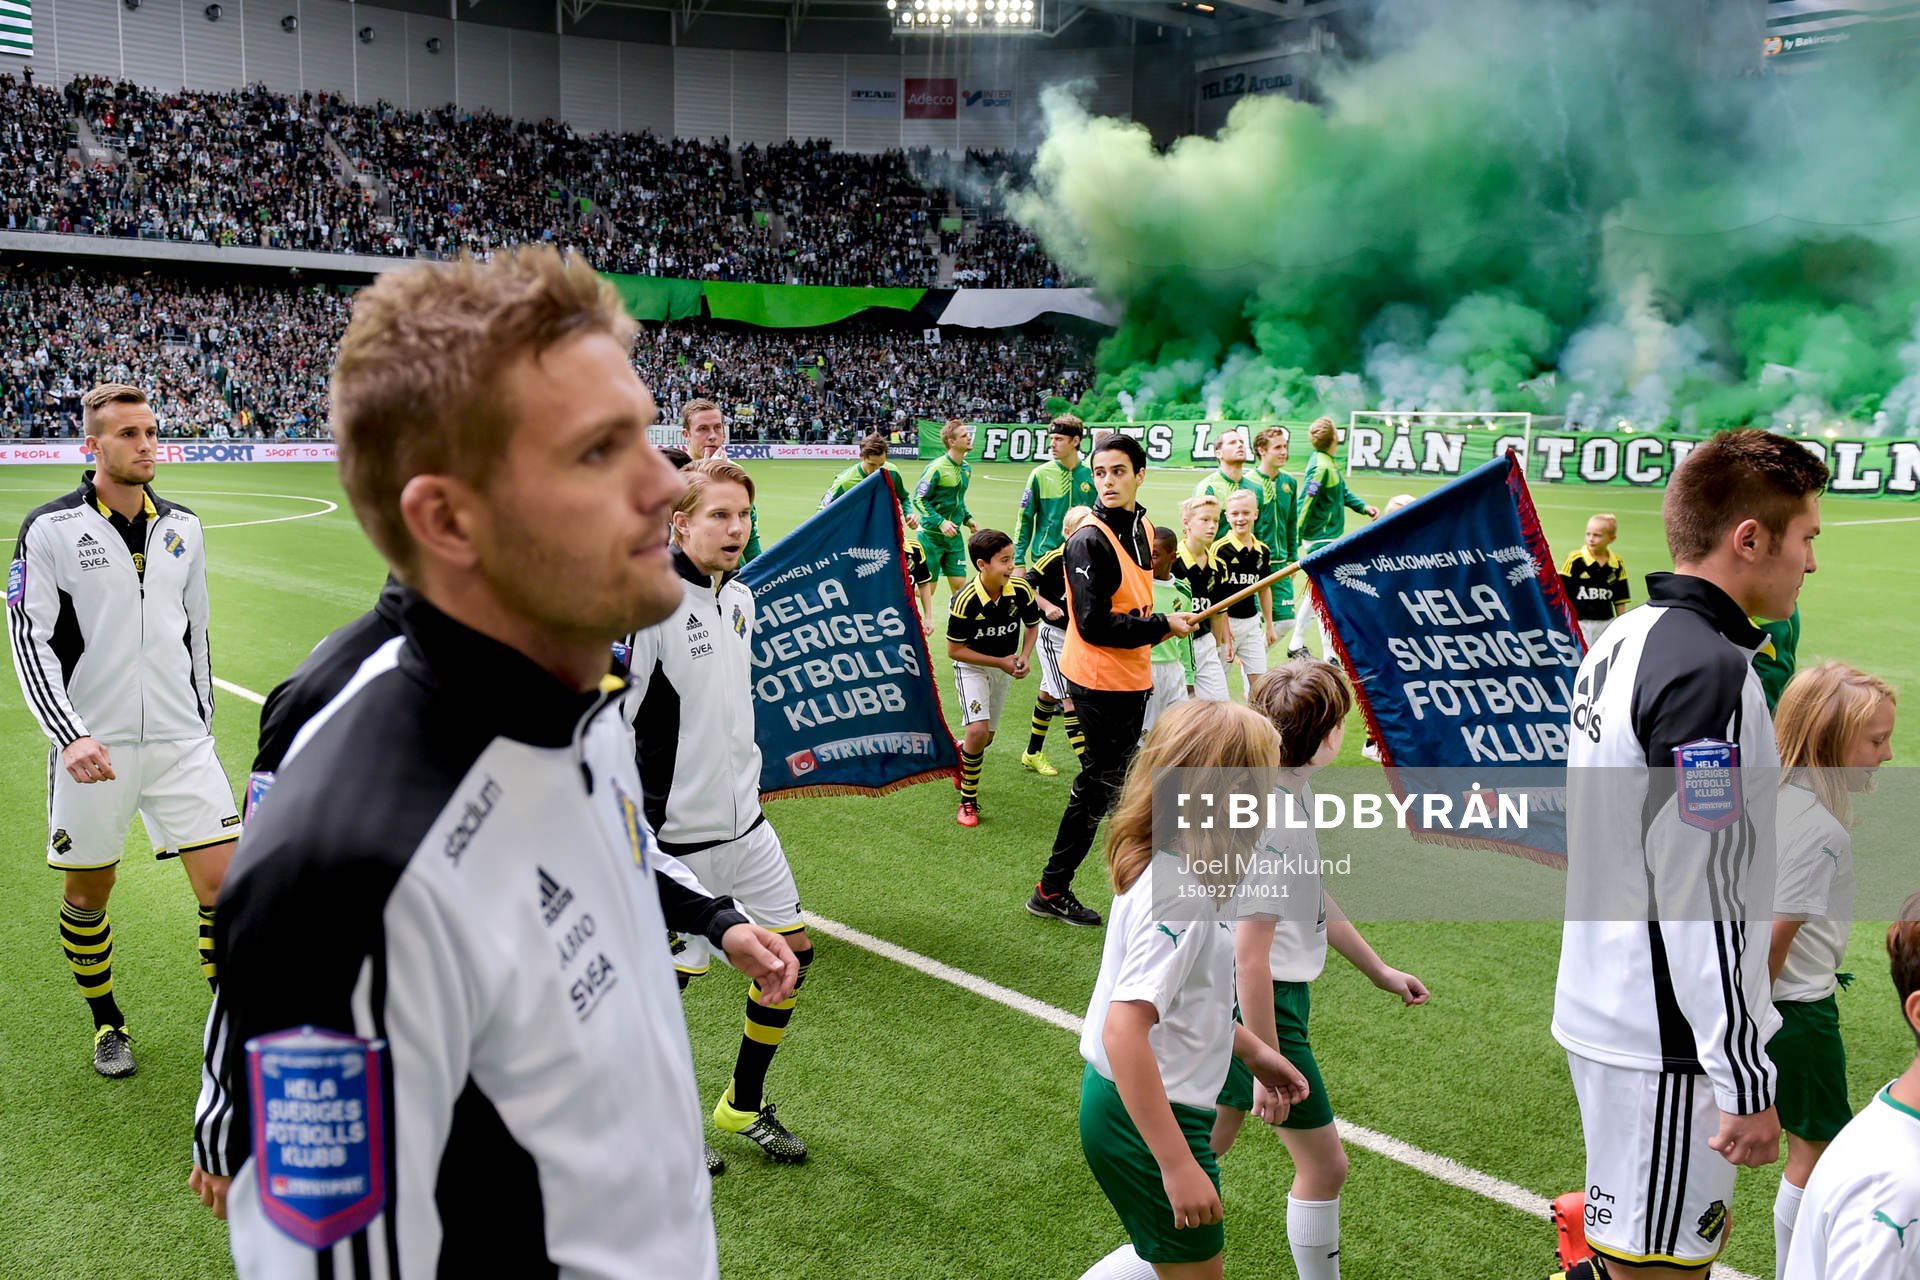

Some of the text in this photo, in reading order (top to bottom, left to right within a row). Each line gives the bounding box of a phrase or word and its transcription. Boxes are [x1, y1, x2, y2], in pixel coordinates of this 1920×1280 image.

[1202, 74, 1292, 99] TELE2 Arena
[908, 93, 954, 105] Adecco
[14, 450, 60, 459] PEOPLE
[265, 449, 299, 457] SPORT
[304, 449, 318, 457] TO
[50, 511, 84, 523] stadium
[78, 547, 106, 559] ÅBRO
[1371, 548, 1487, 573] VÄLKOMMEN IN I
[80, 557, 110, 568] SVEA
[815, 557, 831, 570] IN
[753, 578, 849, 634] HELA
[1398, 584, 1510, 626] HELA
[688, 630, 709, 643] ÅBRO
[690, 643, 713, 657] SVEA
[1388, 628, 1581, 672] SVERIGES
[751, 644, 921, 703] OTBOLLS
[783, 683, 906, 732] KLUBB
[820, 736, 932, 763] STRYKTIPSET
[1695, 760, 1720, 769] HELA
[1686, 769, 1730, 780] SVERIGES
[1685, 779, 1731, 789] FOTBOLLS
[1695, 788, 1724, 798] KLUBB
[570, 953, 615, 1012] SVEA
[283, 1078, 338, 1099] HELA
[267, 1099, 362, 1123] SVERIGES
[266, 1121, 366, 1144] FOTBOLLS
[281, 1145, 348, 1167] KLUBB
